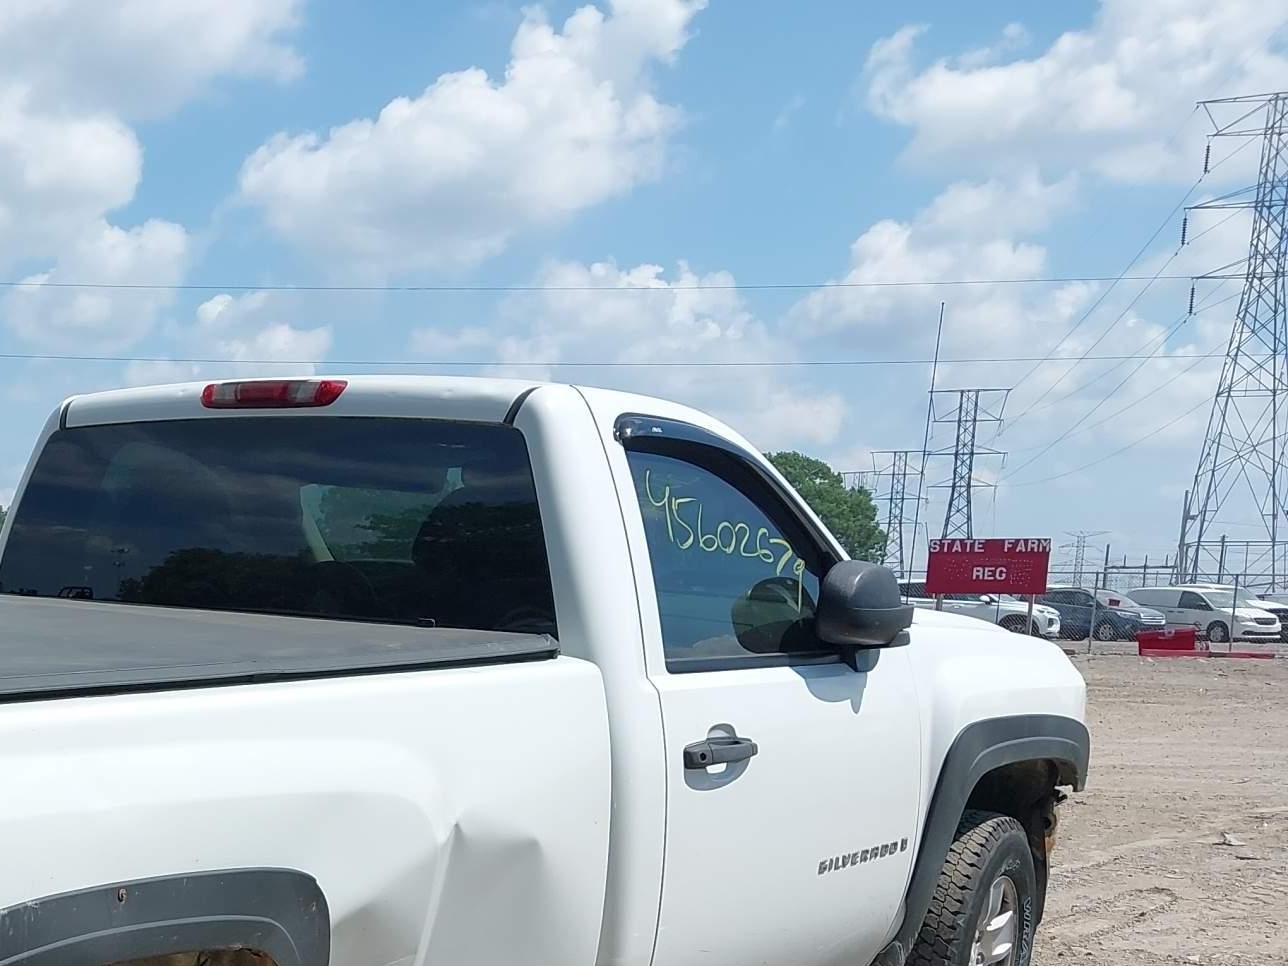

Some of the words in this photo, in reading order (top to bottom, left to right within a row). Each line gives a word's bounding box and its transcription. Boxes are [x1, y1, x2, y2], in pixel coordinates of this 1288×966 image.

[645, 469, 806, 614] 45602679
[930, 539, 985, 553] STATE
[1004, 539, 1050, 553] FARM
[972, 566, 1007, 580] REG
